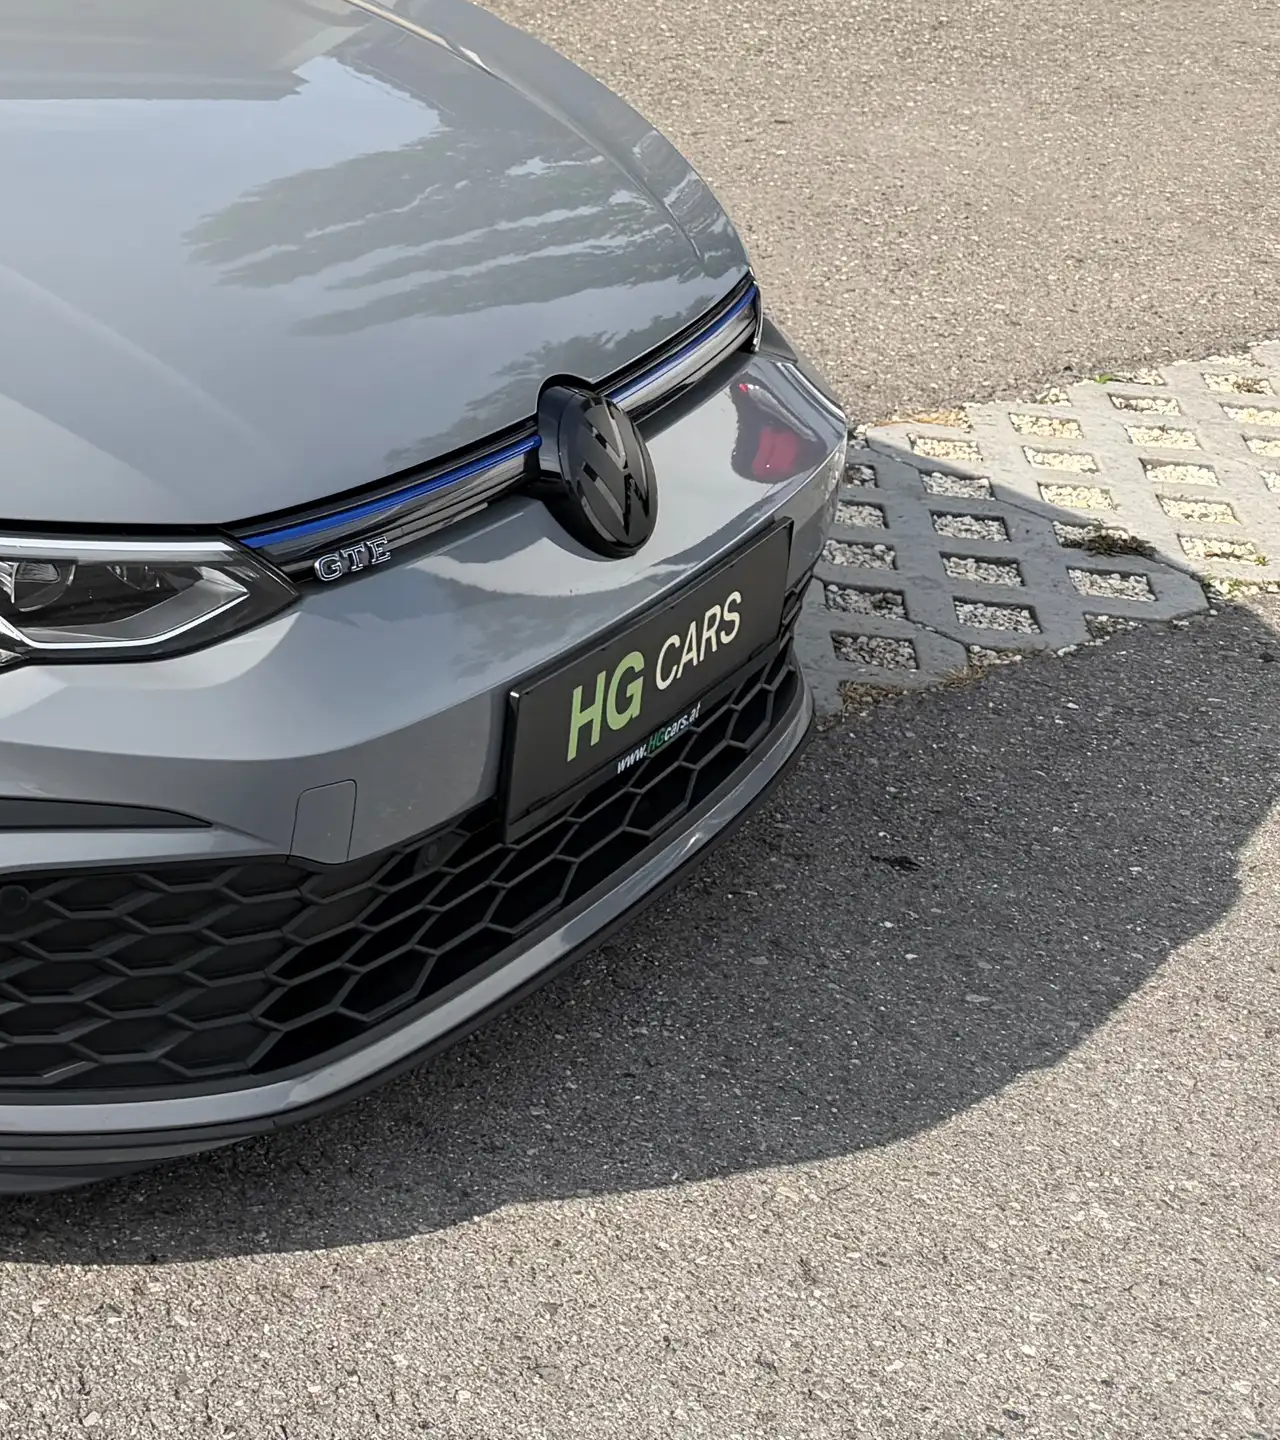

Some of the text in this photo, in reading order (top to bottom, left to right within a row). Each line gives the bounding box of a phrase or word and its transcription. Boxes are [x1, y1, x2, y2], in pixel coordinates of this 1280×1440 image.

[314, 536, 391, 581] GTE
[567, 590, 742, 763] HG CARS
[616, 701, 702, 775] www.HGcars.at
